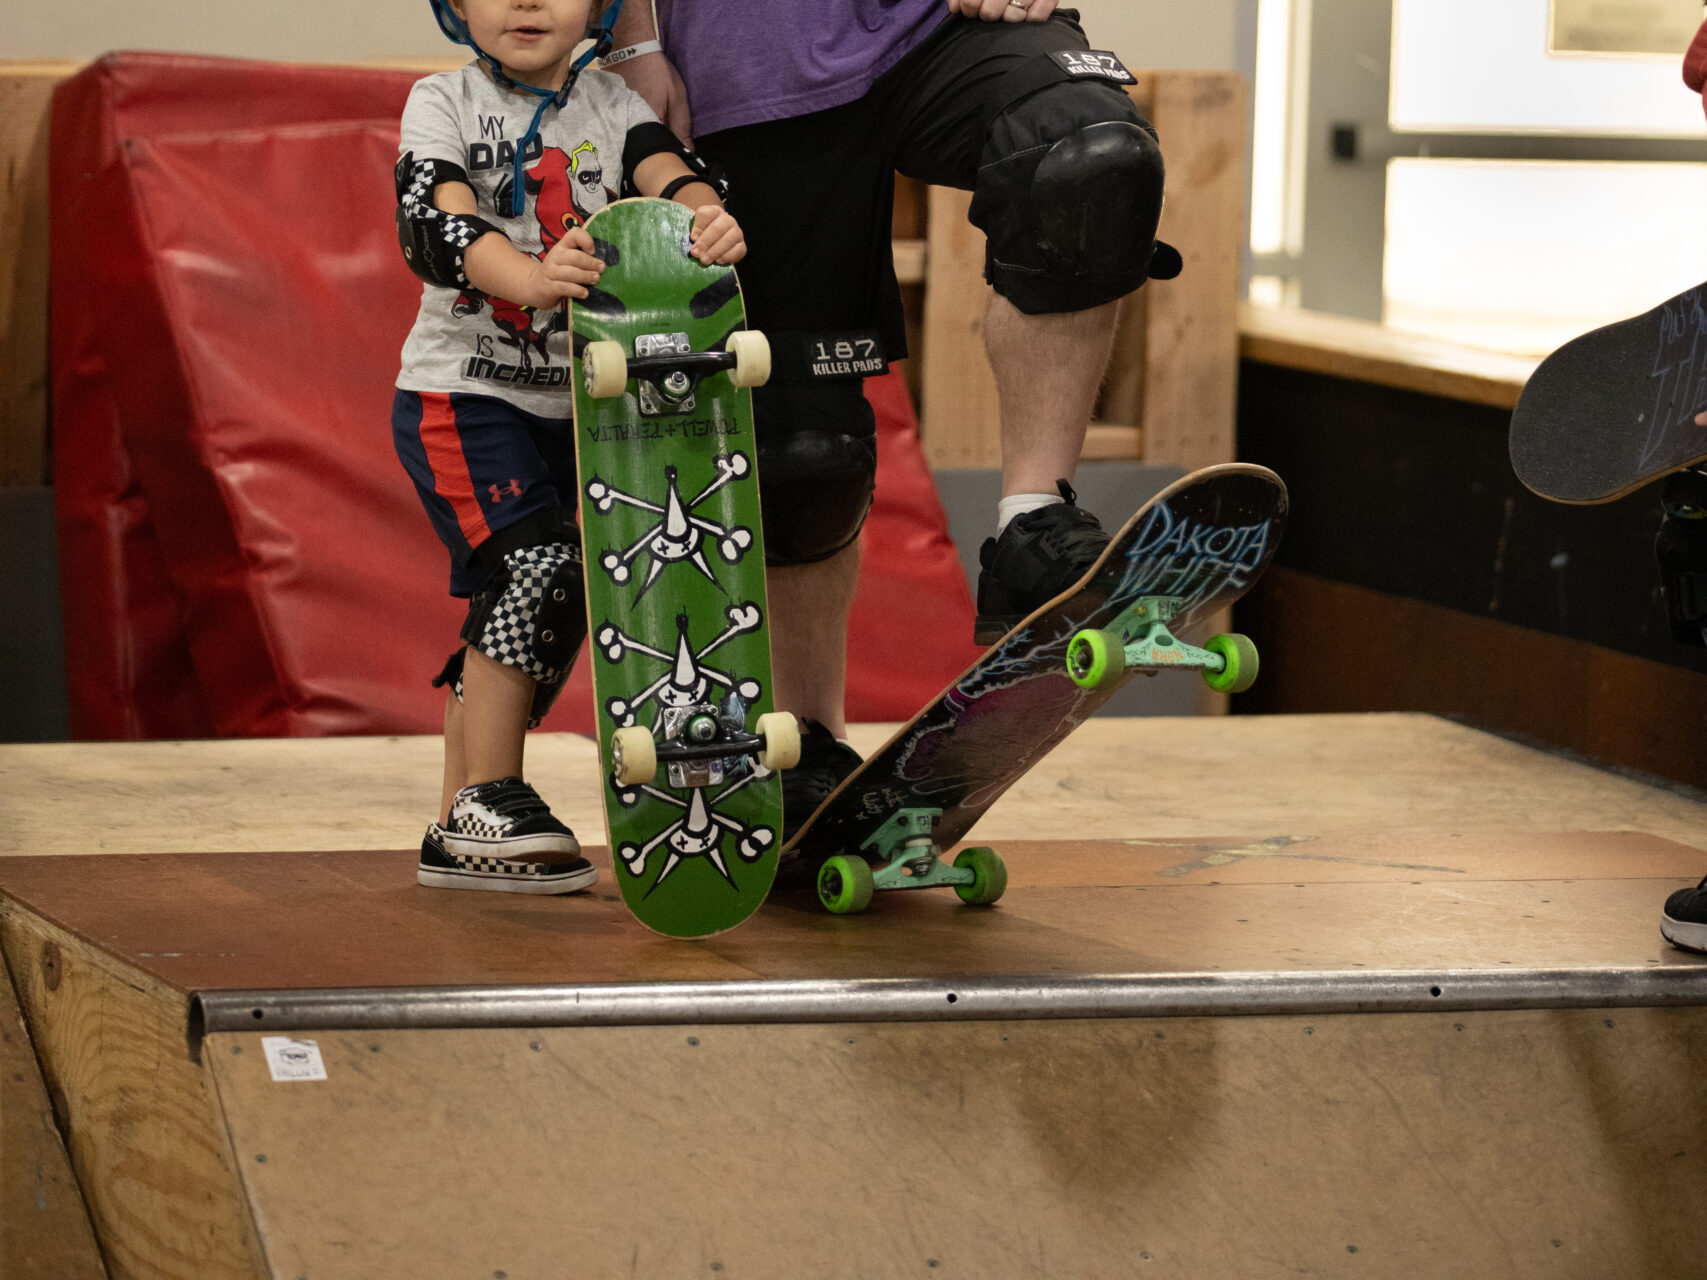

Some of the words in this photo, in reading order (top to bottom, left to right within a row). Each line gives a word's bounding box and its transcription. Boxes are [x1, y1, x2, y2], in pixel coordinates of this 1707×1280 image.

[1062, 53, 1116, 69] 187
[478, 114, 505, 140] MY
[469, 131, 544, 171] DAD
[476, 333, 494, 358] IS
[816, 339, 875, 360] 187
[812, 361, 852, 376] KILLER
[852, 358, 883, 373] PADS
[1126, 500, 1272, 569] DAKOTA
